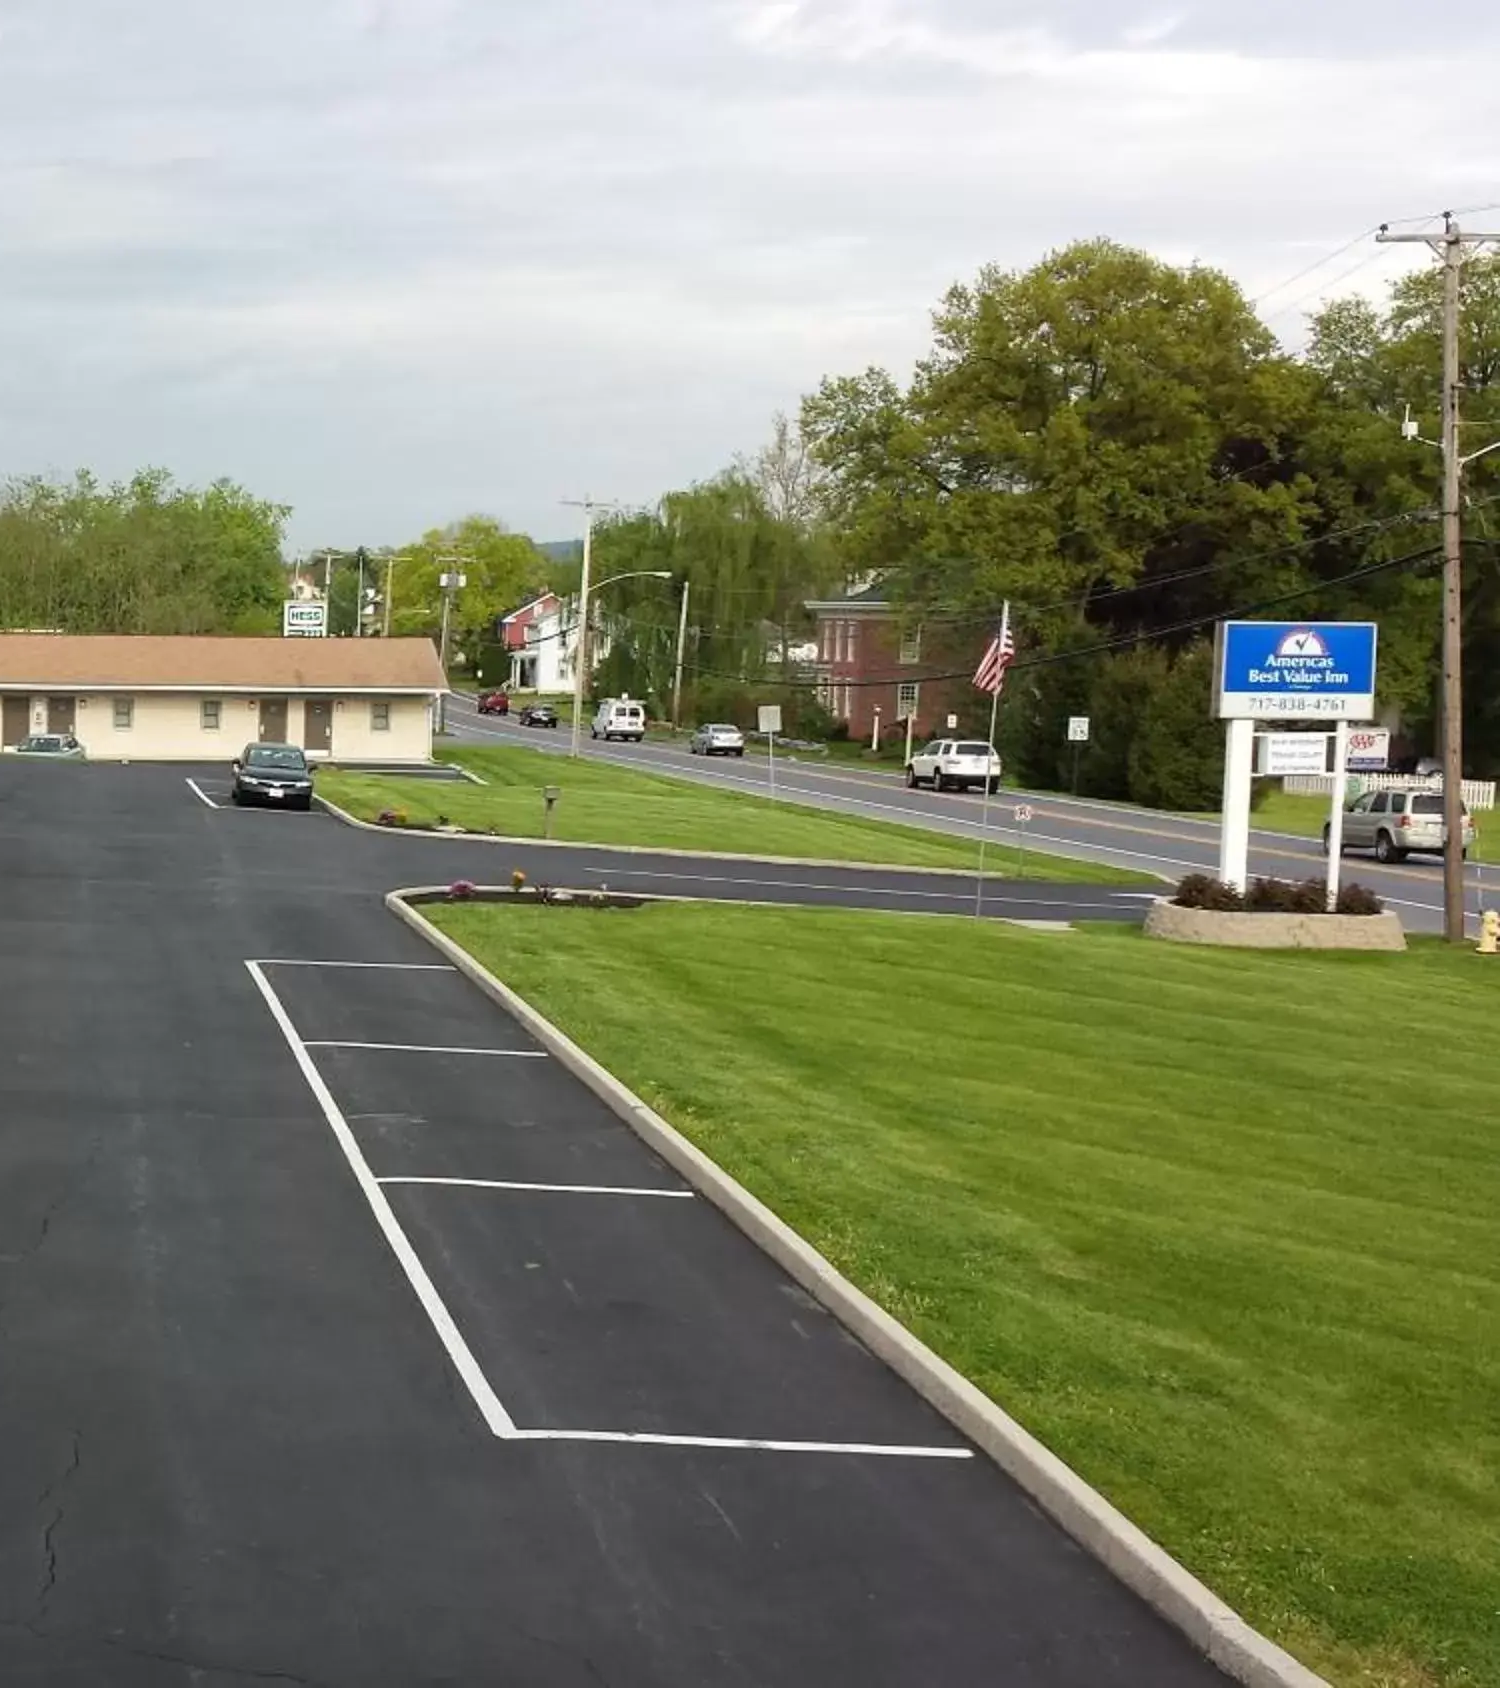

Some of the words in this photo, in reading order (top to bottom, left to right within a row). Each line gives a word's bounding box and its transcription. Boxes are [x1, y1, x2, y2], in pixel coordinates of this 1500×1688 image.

[291, 611, 321, 621] HESS
[1265, 654, 1335, 668] Americas
[1248, 669, 1280, 683] Best
[1283, 669, 1322, 683] Value
[1325, 670, 1349, 684] Inn
[1250, 697, 1346, 711] 717-838-4761
